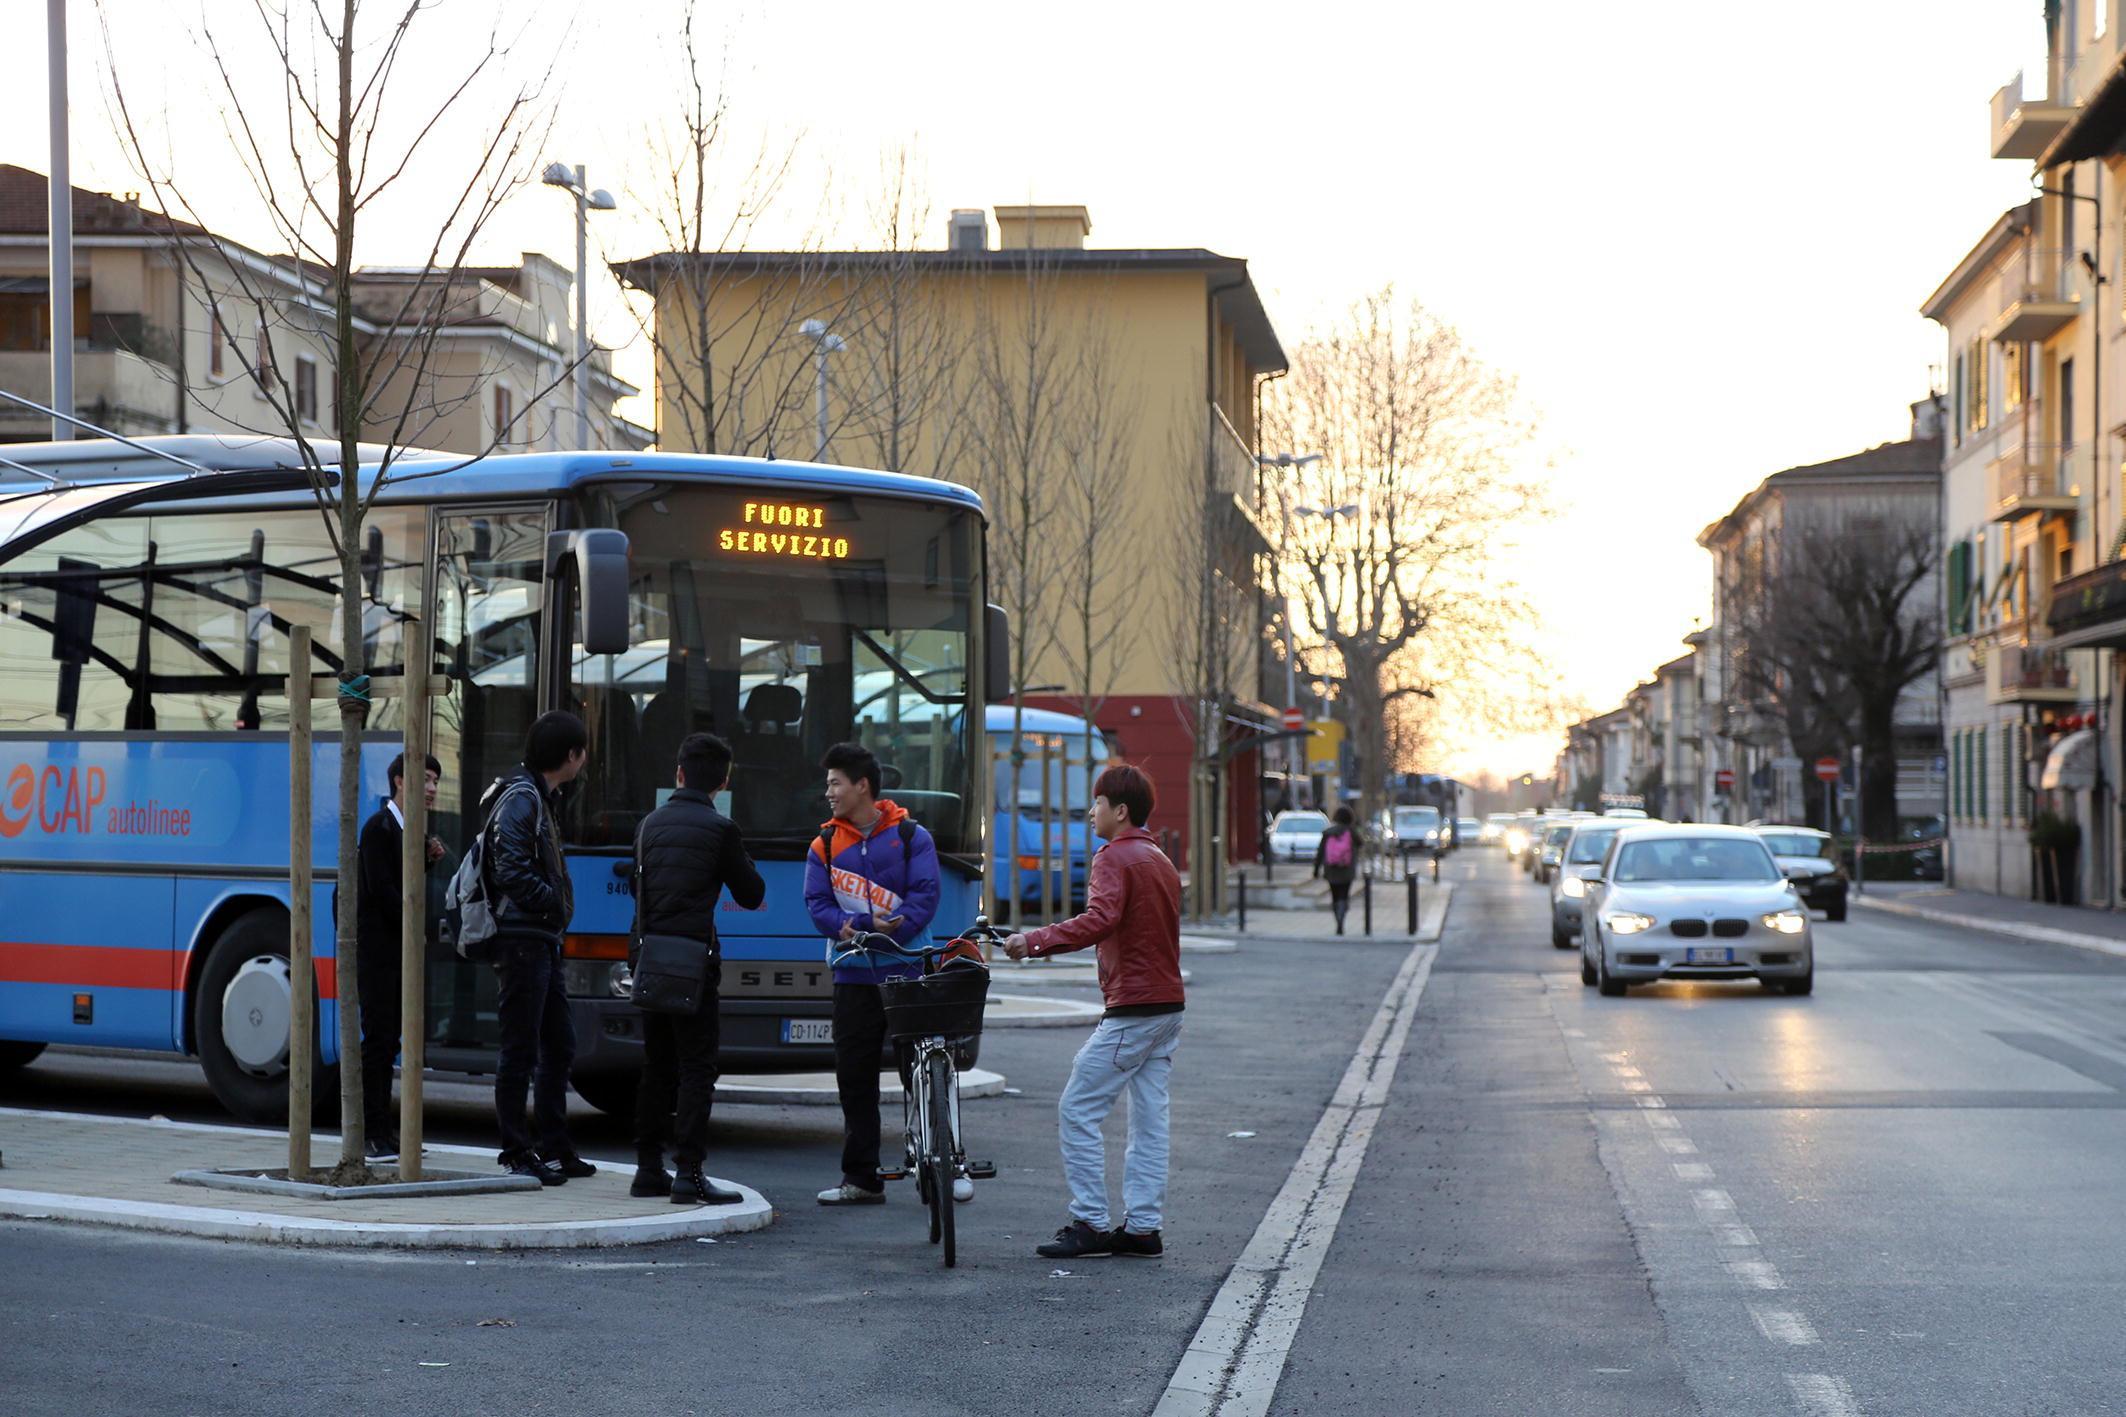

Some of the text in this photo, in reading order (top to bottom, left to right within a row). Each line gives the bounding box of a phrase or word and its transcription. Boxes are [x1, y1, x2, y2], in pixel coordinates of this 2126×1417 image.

[744, 503, 823, 528] FUORI
[719, 530, 849, 559] SERVIZIO
[38, 764, 192, 837] CAP autolinee
[740, 971, 822, 987] SET
